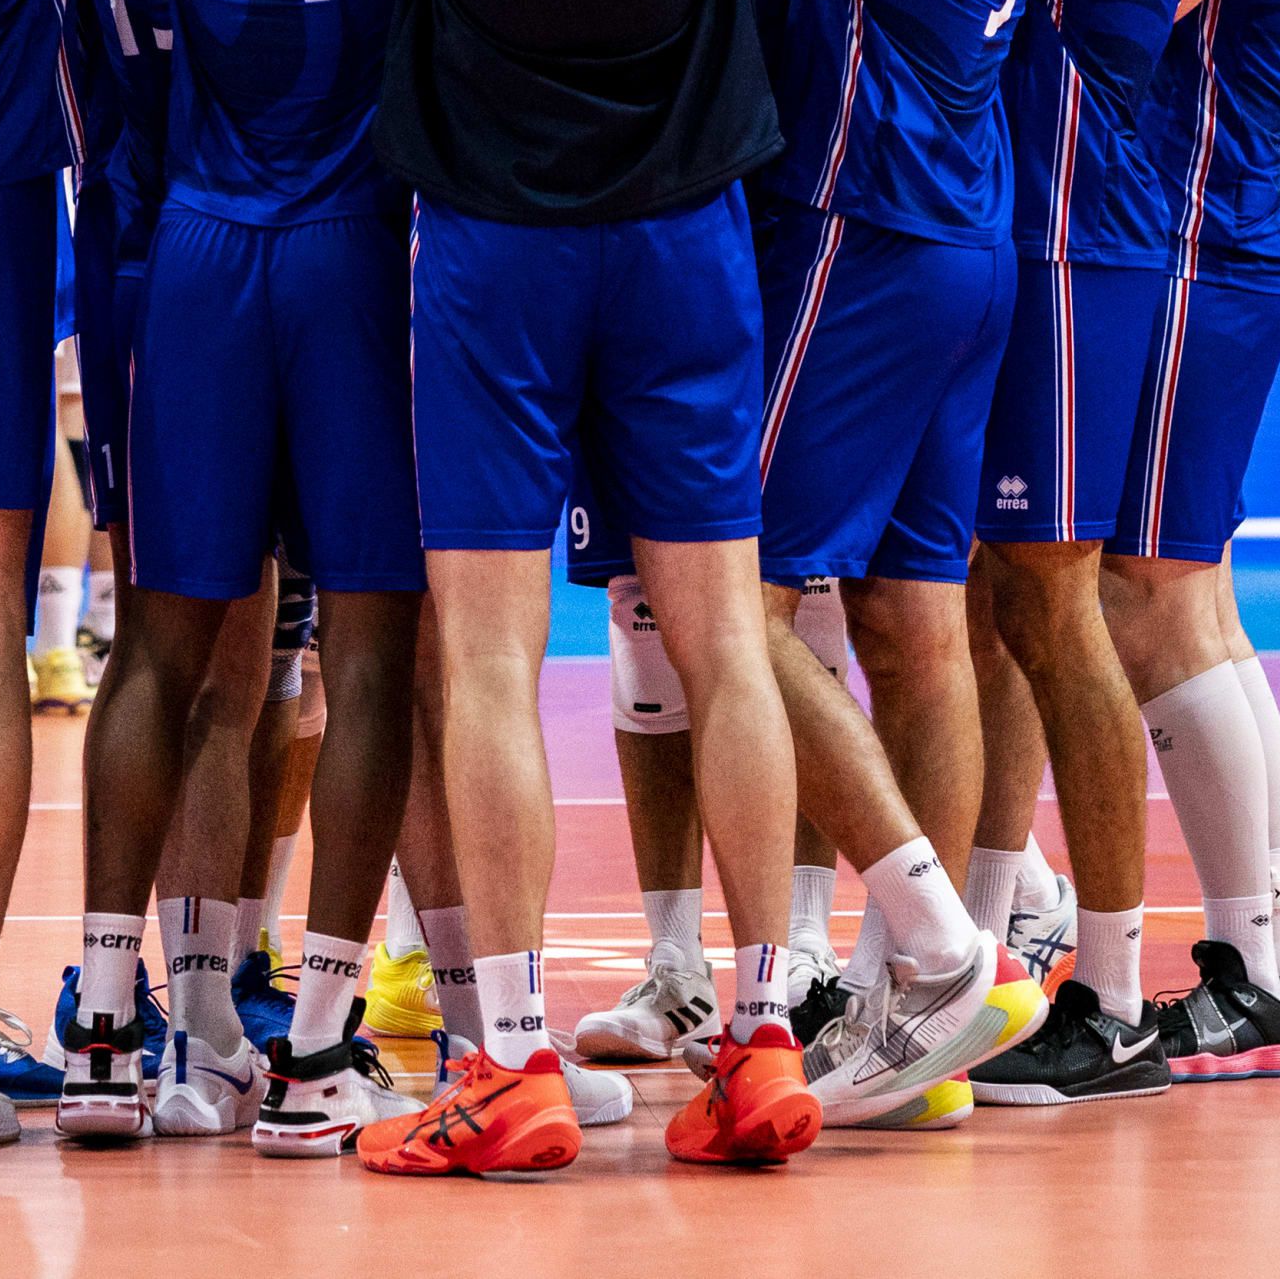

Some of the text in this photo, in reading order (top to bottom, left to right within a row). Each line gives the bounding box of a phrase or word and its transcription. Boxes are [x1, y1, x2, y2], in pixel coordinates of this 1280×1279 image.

[996, 498, 1029, 510] errea
[571, 506, 590, 550] 9
[633, 621, 658, 631] erre
[172, 953, 229, 976] errea
[749, 1000, 789, 1019] errea
